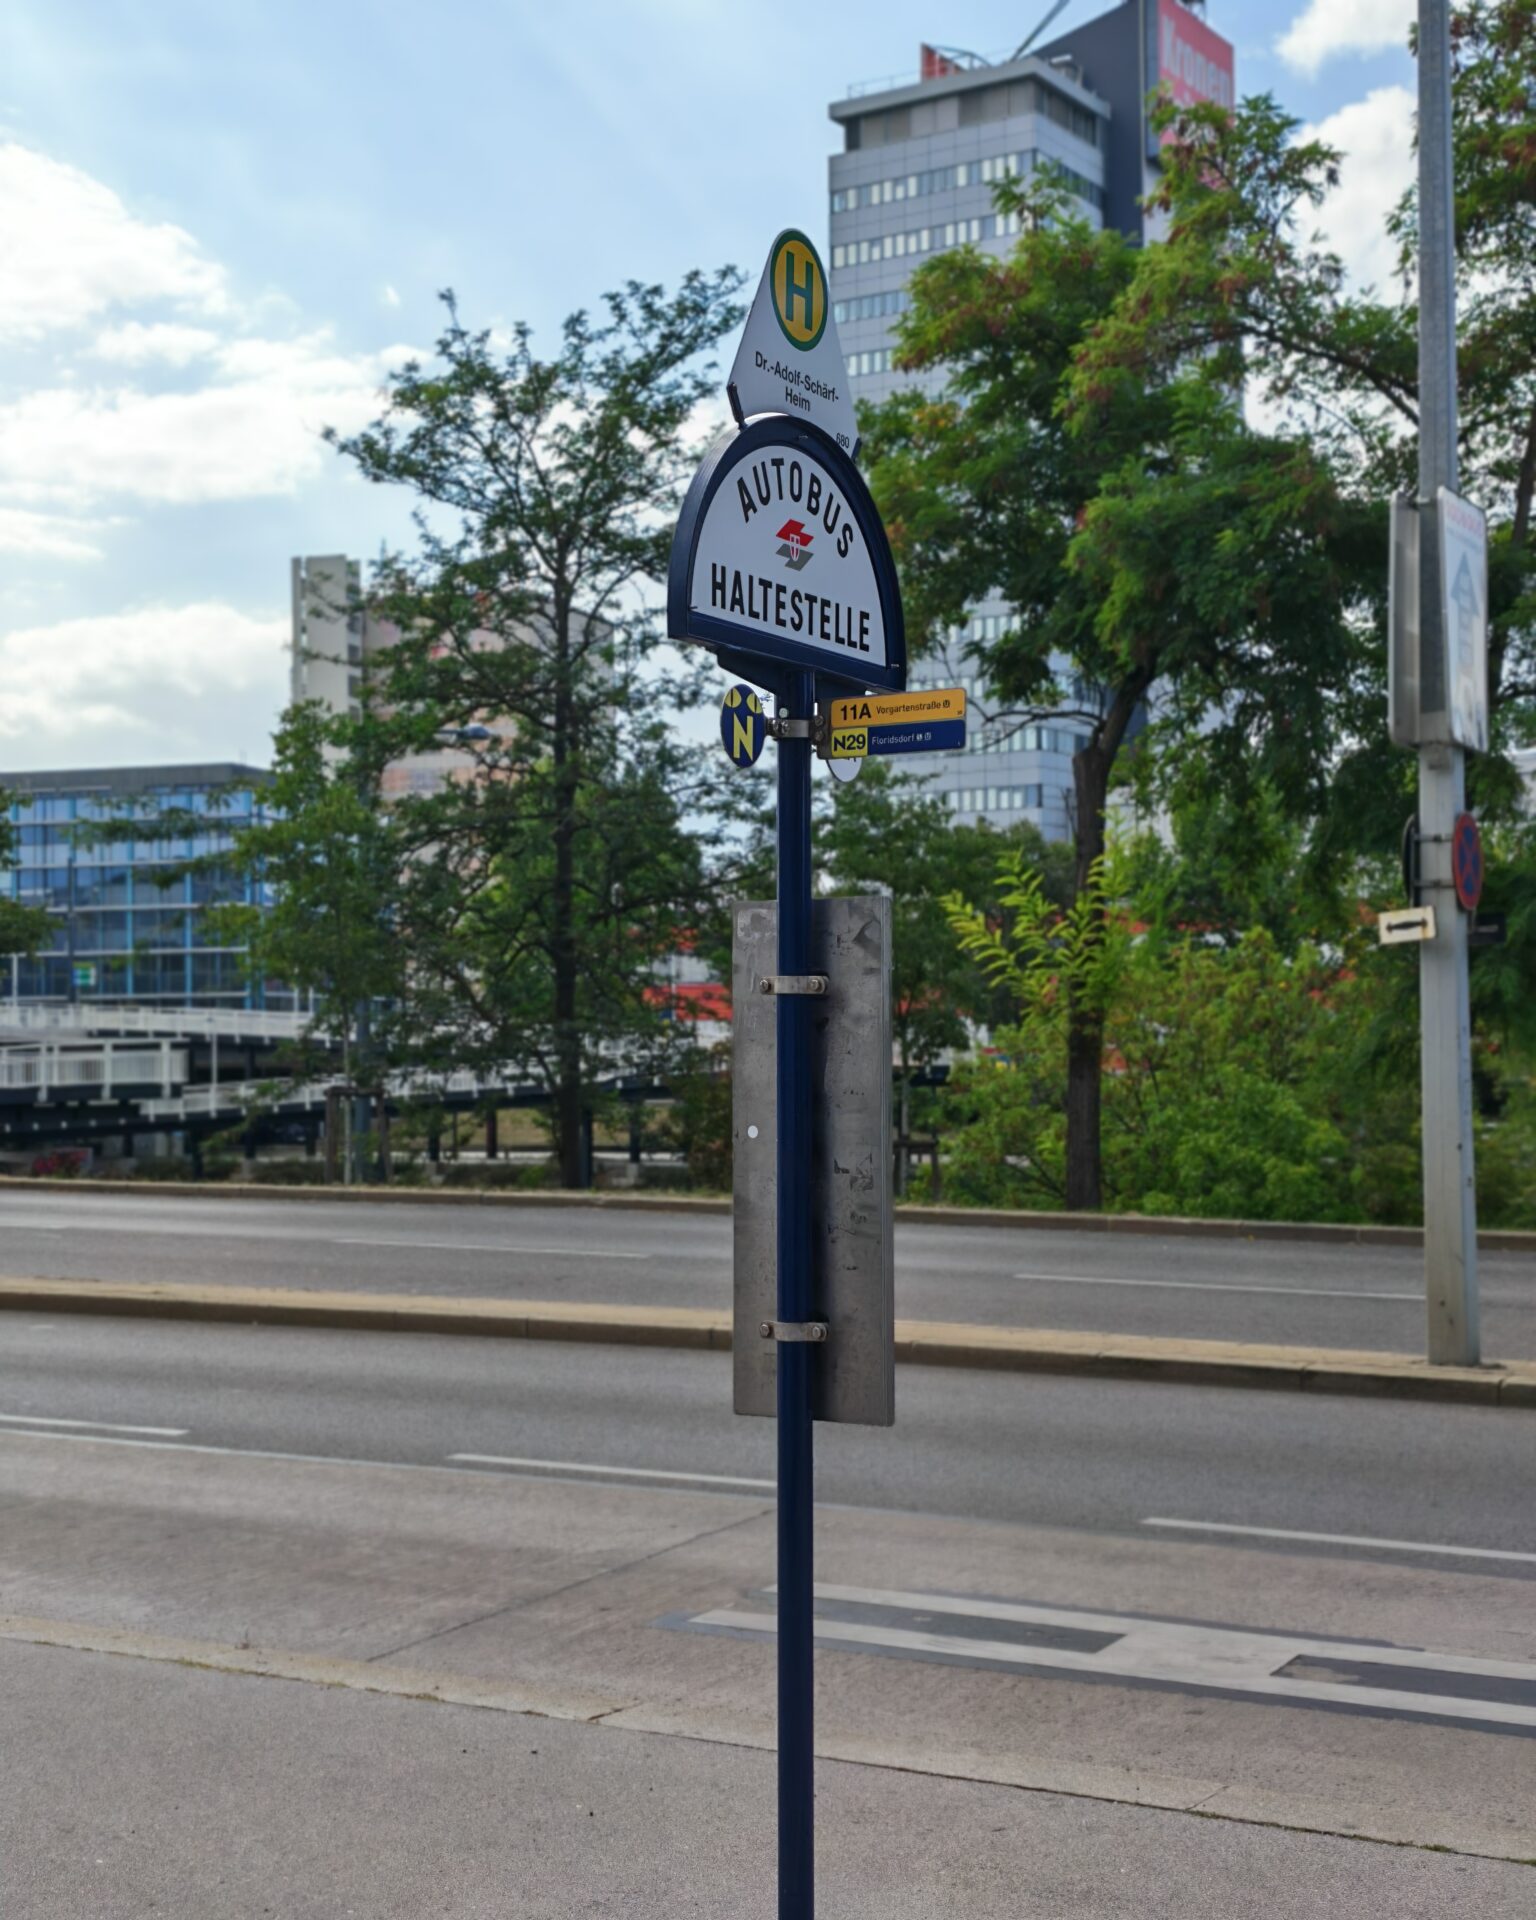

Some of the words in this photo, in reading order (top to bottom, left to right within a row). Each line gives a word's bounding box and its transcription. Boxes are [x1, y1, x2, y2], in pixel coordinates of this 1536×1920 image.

[785, 250, 814, 332] H
[755, 351, 839, 402] Dr.-Adolf-Schärf-
[785, 386, 811, 412] Heim
[836, 432, 850, 449] 680
[736, 457, 854, 559] AUTOBUS
[711, 562, 870, 653] HALTESTELLE
[733, 711, 754, 761] N
[840, 703, 872, 721] 11A
[876, 701, 941, 715] Vorgartenstraße
[833, 733, 866, 752] N29
[871, 733, 915, 745] Floridsdorf
